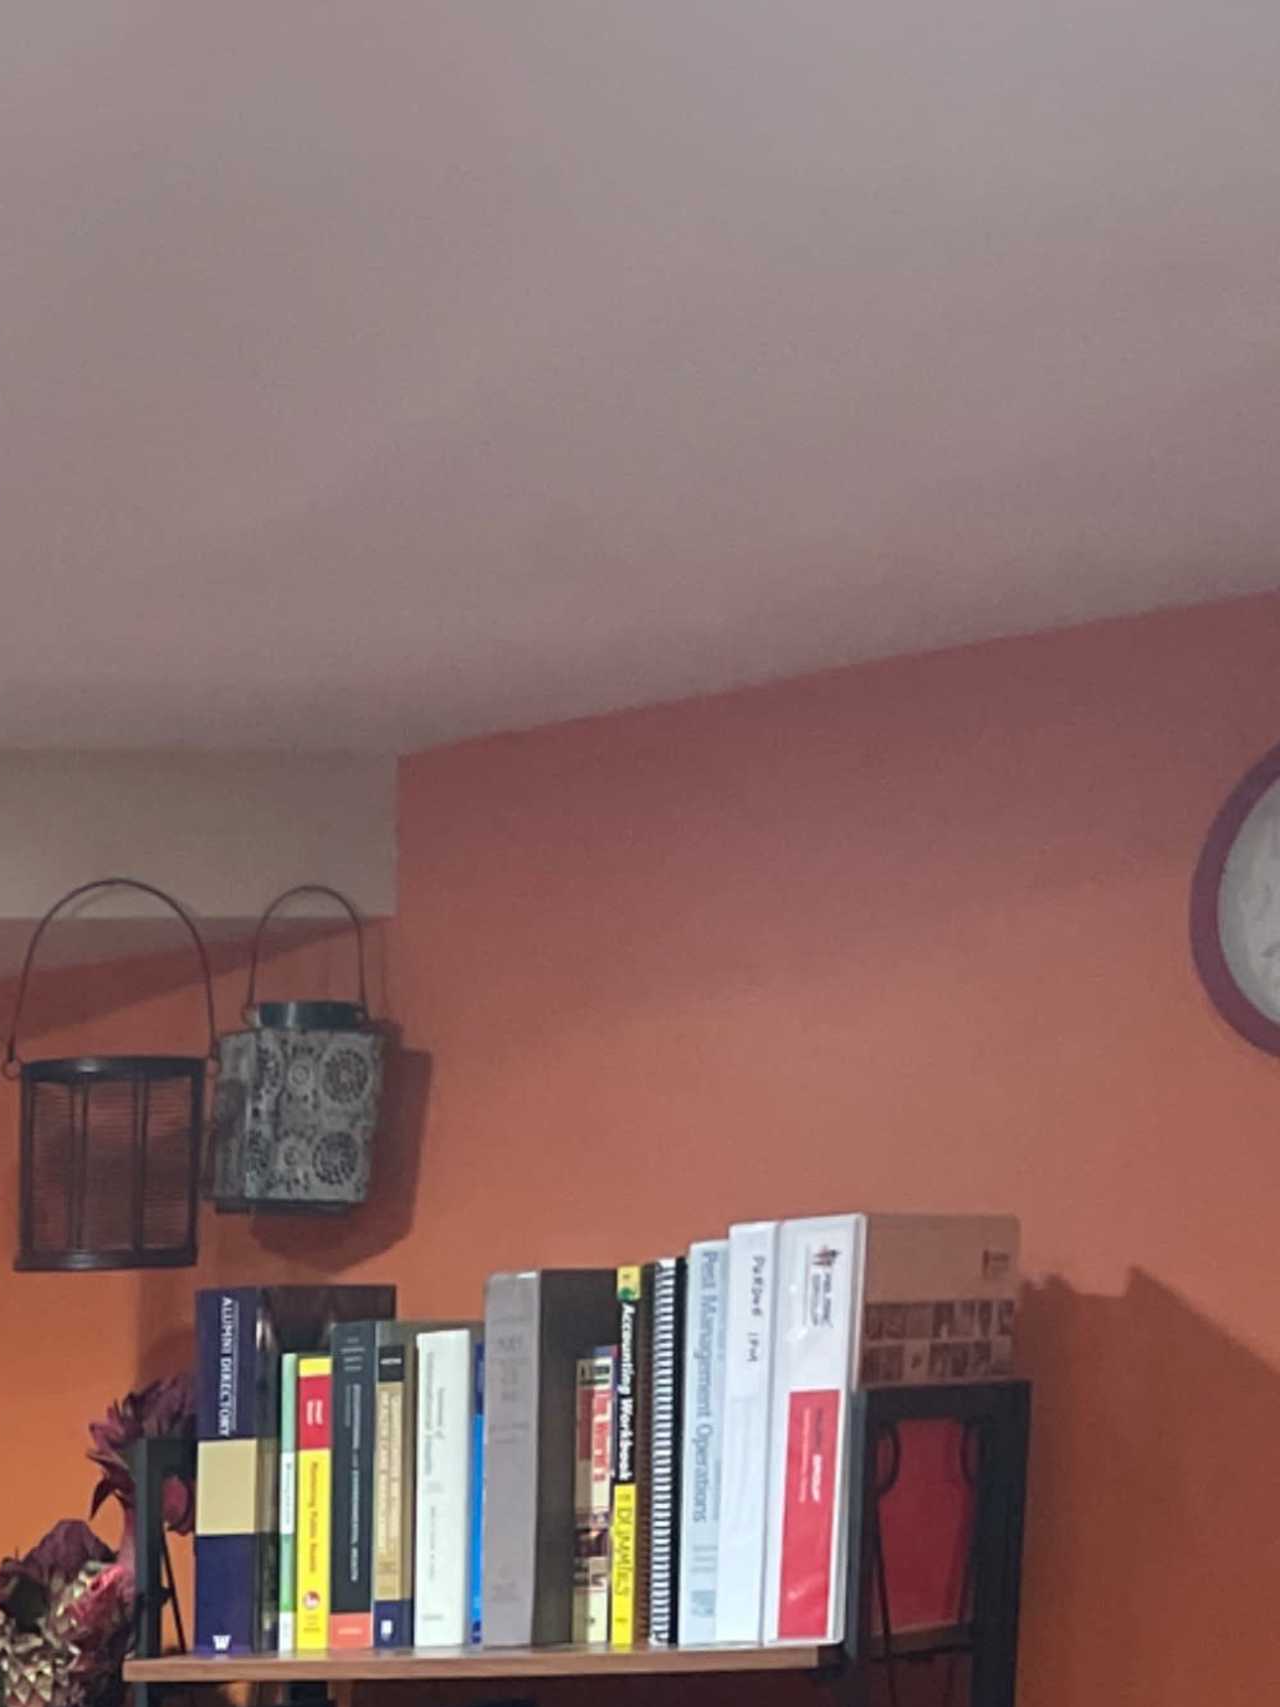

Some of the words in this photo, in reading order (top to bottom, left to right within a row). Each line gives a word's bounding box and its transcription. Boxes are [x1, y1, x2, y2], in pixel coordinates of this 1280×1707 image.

[700, 1251, 720, 1288] Pest
[219, 1297, 236, 1354] ALUMNI
[616, 1304, 634, 1393] Accounting
[692, 1294, 717, 1413] Management
[214, 1356, 233, 1435] DIRECTORY
[615, 1397, 633, 1481] Workbook
[690, 1421, 713, 1523] Operations
[611, 1505, 633, 1596] DUMMIES
